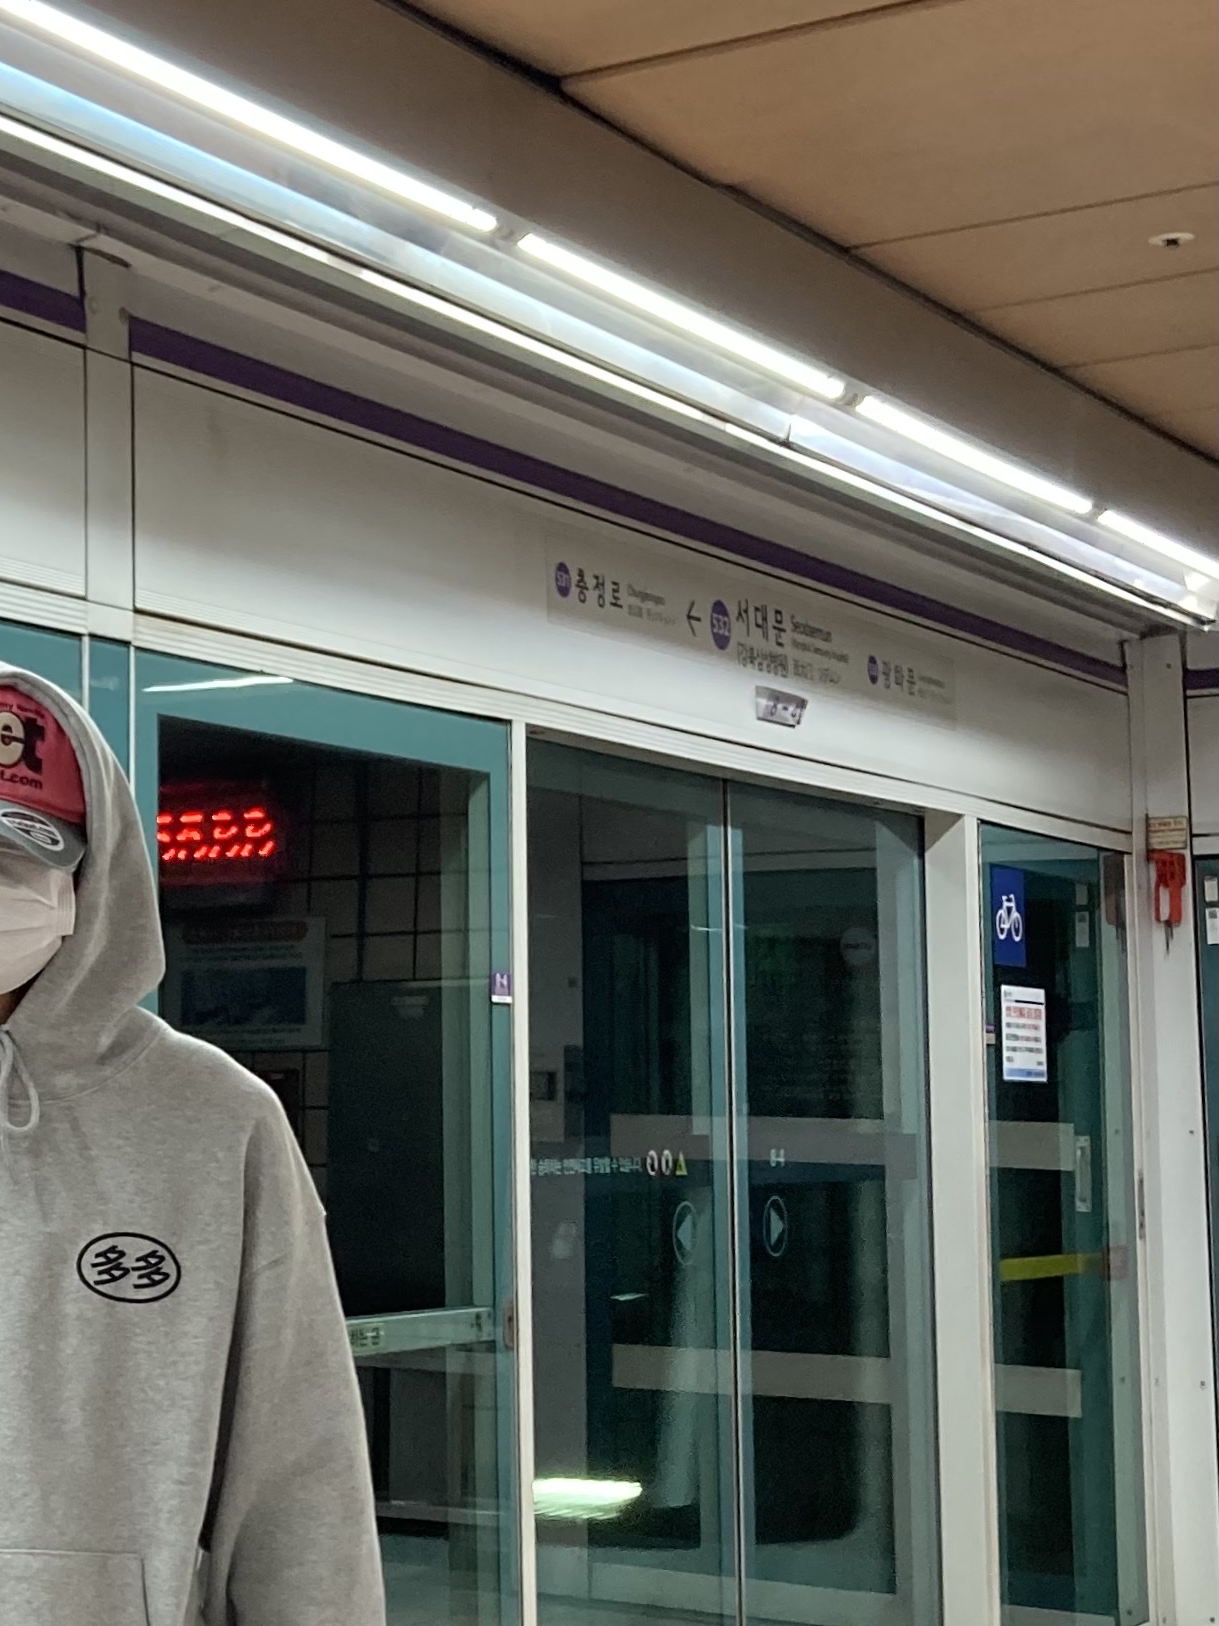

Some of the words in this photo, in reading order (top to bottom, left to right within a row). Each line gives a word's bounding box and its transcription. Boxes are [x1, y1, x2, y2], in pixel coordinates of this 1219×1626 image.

[575, 568, 623, 609] 충정로
[712, 612, 730, 637] 532
[736, 599, 786, 648] 서대문
[90, 1244, 170, 1290] 多多
